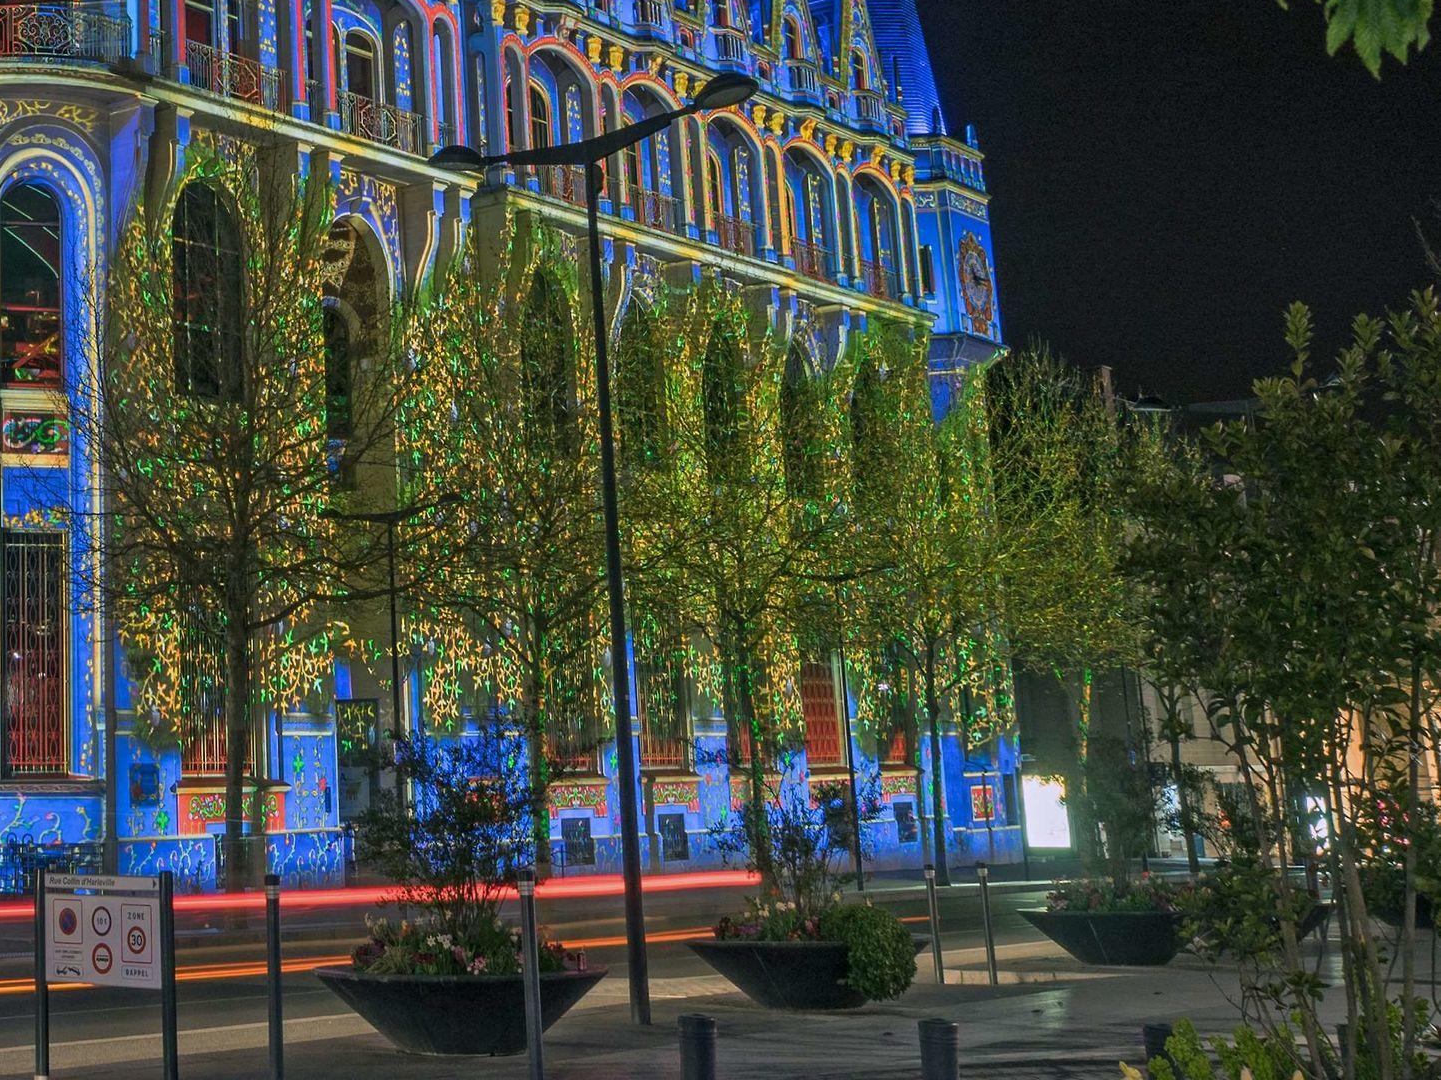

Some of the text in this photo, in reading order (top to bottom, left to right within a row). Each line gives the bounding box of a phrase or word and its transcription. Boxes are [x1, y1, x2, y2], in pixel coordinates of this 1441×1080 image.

[49, 876, 62, 886] Rue
[127, 912, 145, 921] ZONE
[131, 934, 143, 947] 30
